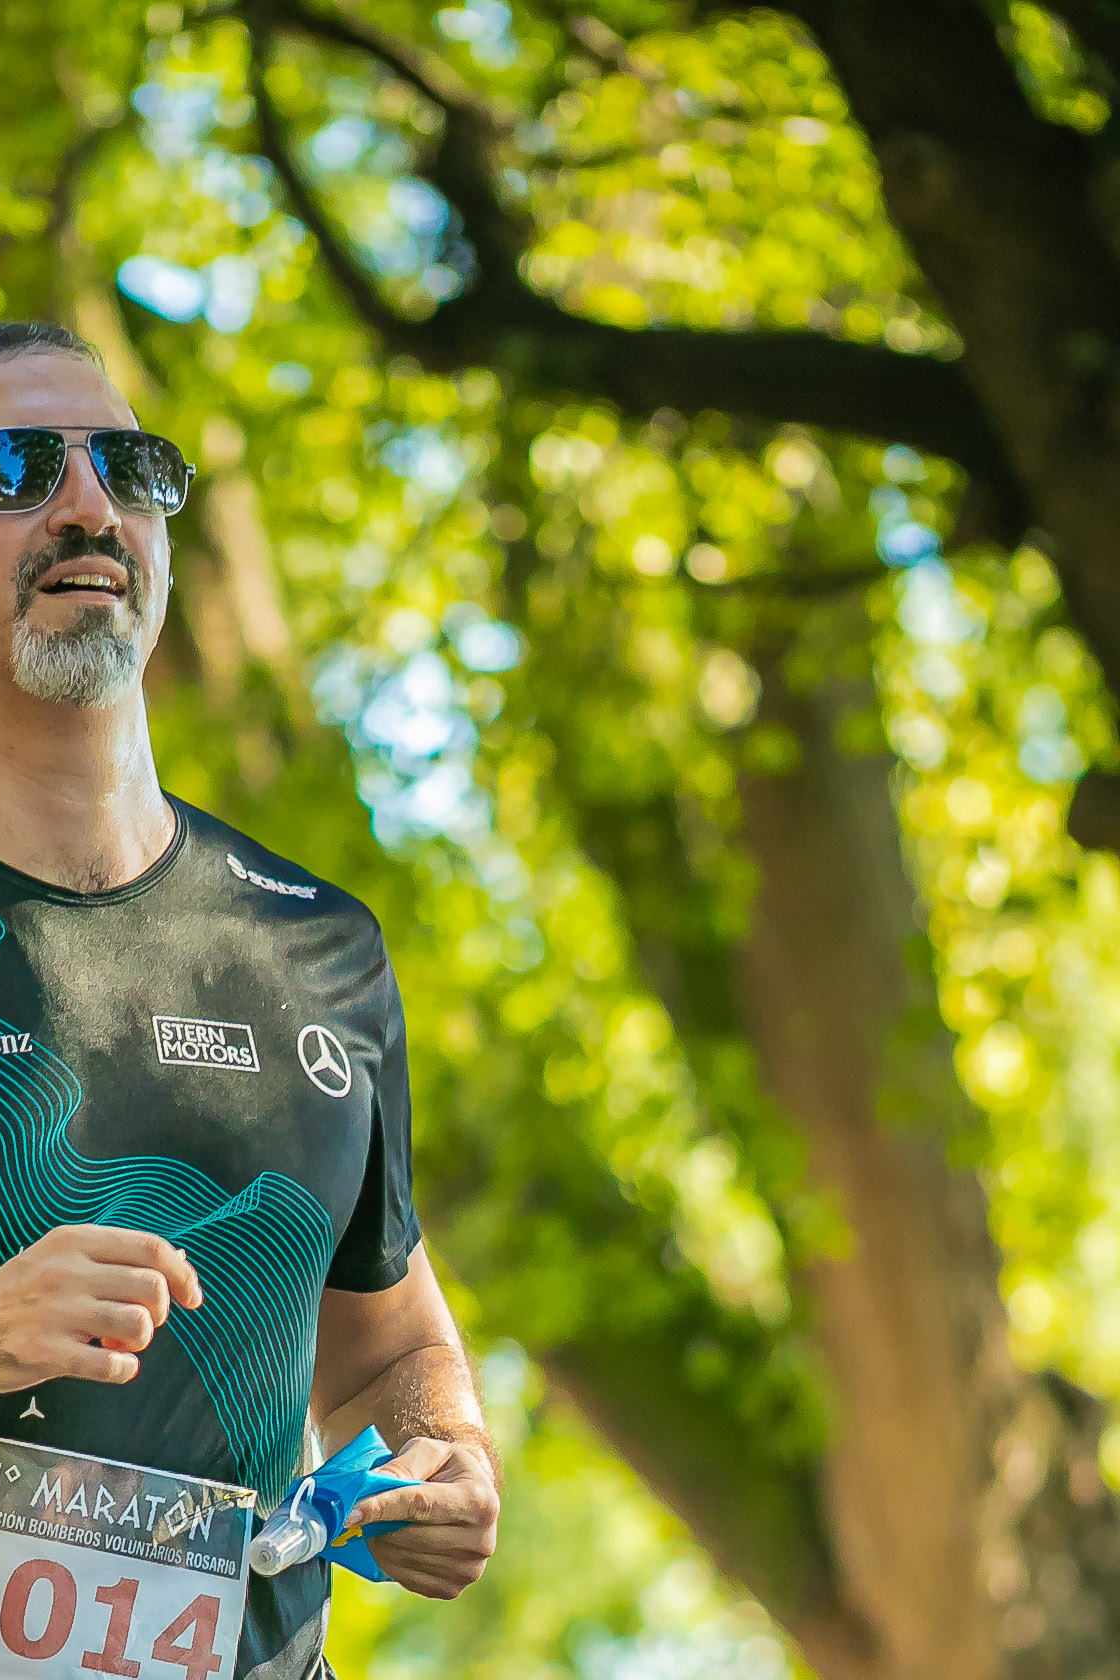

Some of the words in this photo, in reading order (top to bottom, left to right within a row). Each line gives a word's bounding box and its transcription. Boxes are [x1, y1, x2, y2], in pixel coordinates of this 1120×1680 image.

[160, 1022, 226, 1045] STERN
[163, 1040, 253, 1065] MOTORS
[30, 1471, 215, 1543] MARATÓN
[29, 1518, 102, 1547] BOMBEROS
[104, 1534, 182, 1564] VOLUNTARIOS
[185, 1551, 237, 1576] ROSARIO
